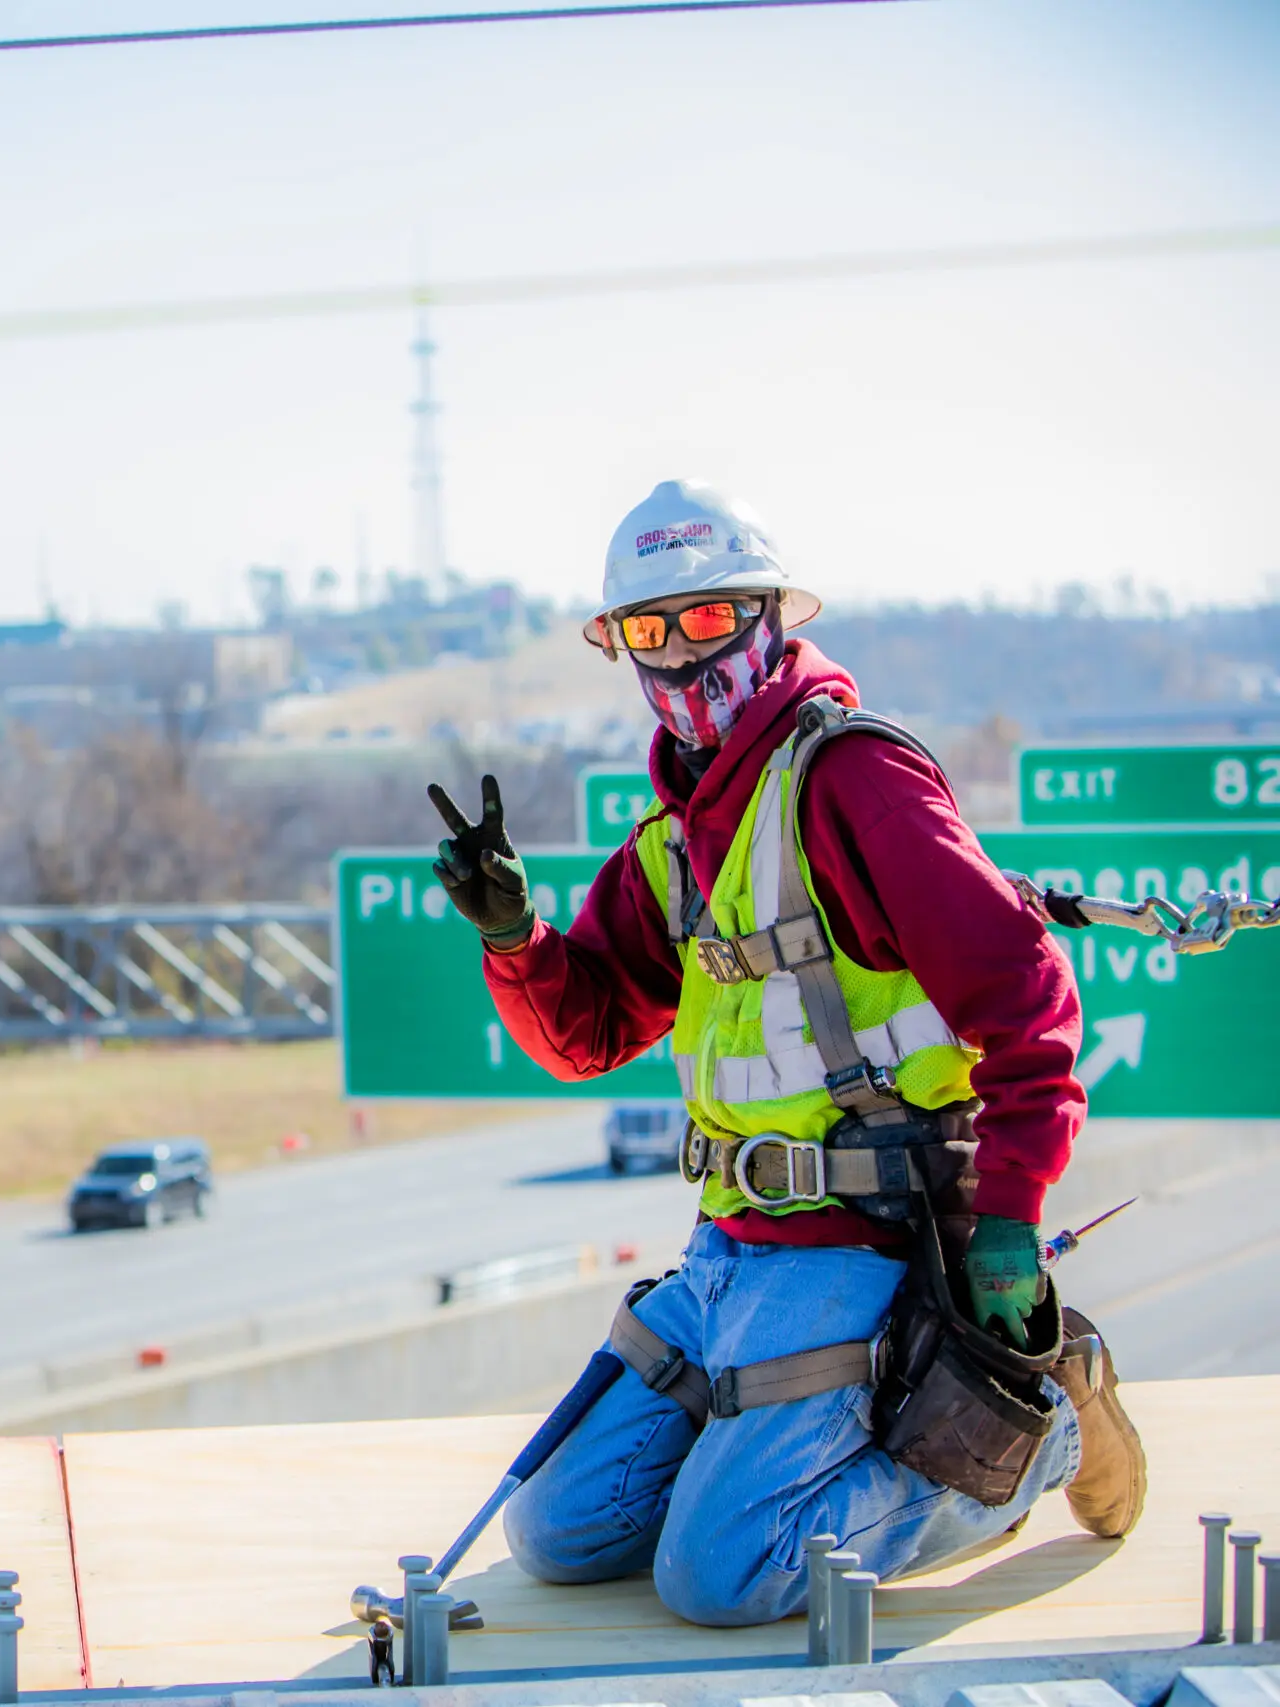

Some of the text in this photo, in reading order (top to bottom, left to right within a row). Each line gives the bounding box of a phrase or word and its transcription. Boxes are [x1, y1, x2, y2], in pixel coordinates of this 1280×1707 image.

[638, 536, 715, 557] HEAVY CONTRACT
[1033, 758, 1280, 805] EXIT 82
[602, 791, 646, 825] EX
[1057, 935, 1177, 982] lvd
